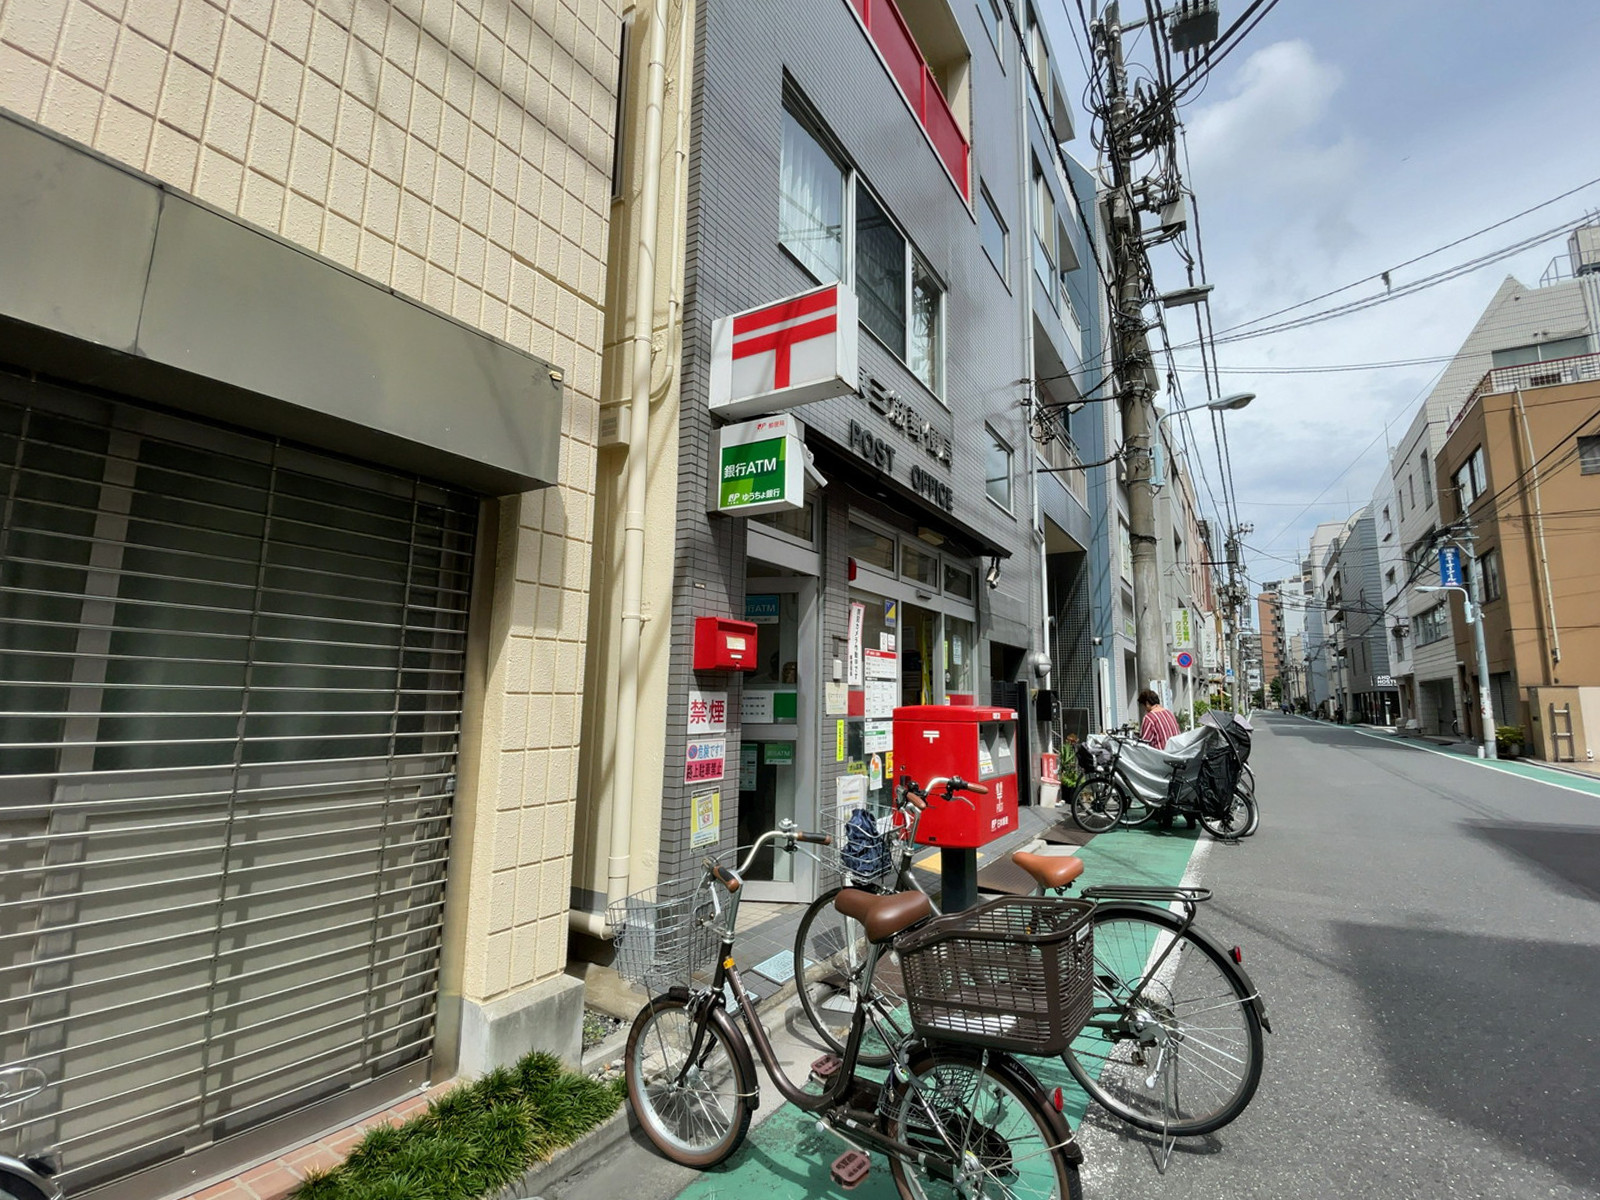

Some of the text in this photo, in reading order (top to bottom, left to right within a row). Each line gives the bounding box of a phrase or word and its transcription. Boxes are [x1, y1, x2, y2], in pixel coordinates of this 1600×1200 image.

[723, 457, 777, 479] 銀行ATM
[849, 418, 954, 512] POST OFFICE
[741, 487, 780, 502] ゆうちょ銀行
[690, 699, 725, 724] 禁煙
[686, 761, 723, 780] 路上駐車禁止
